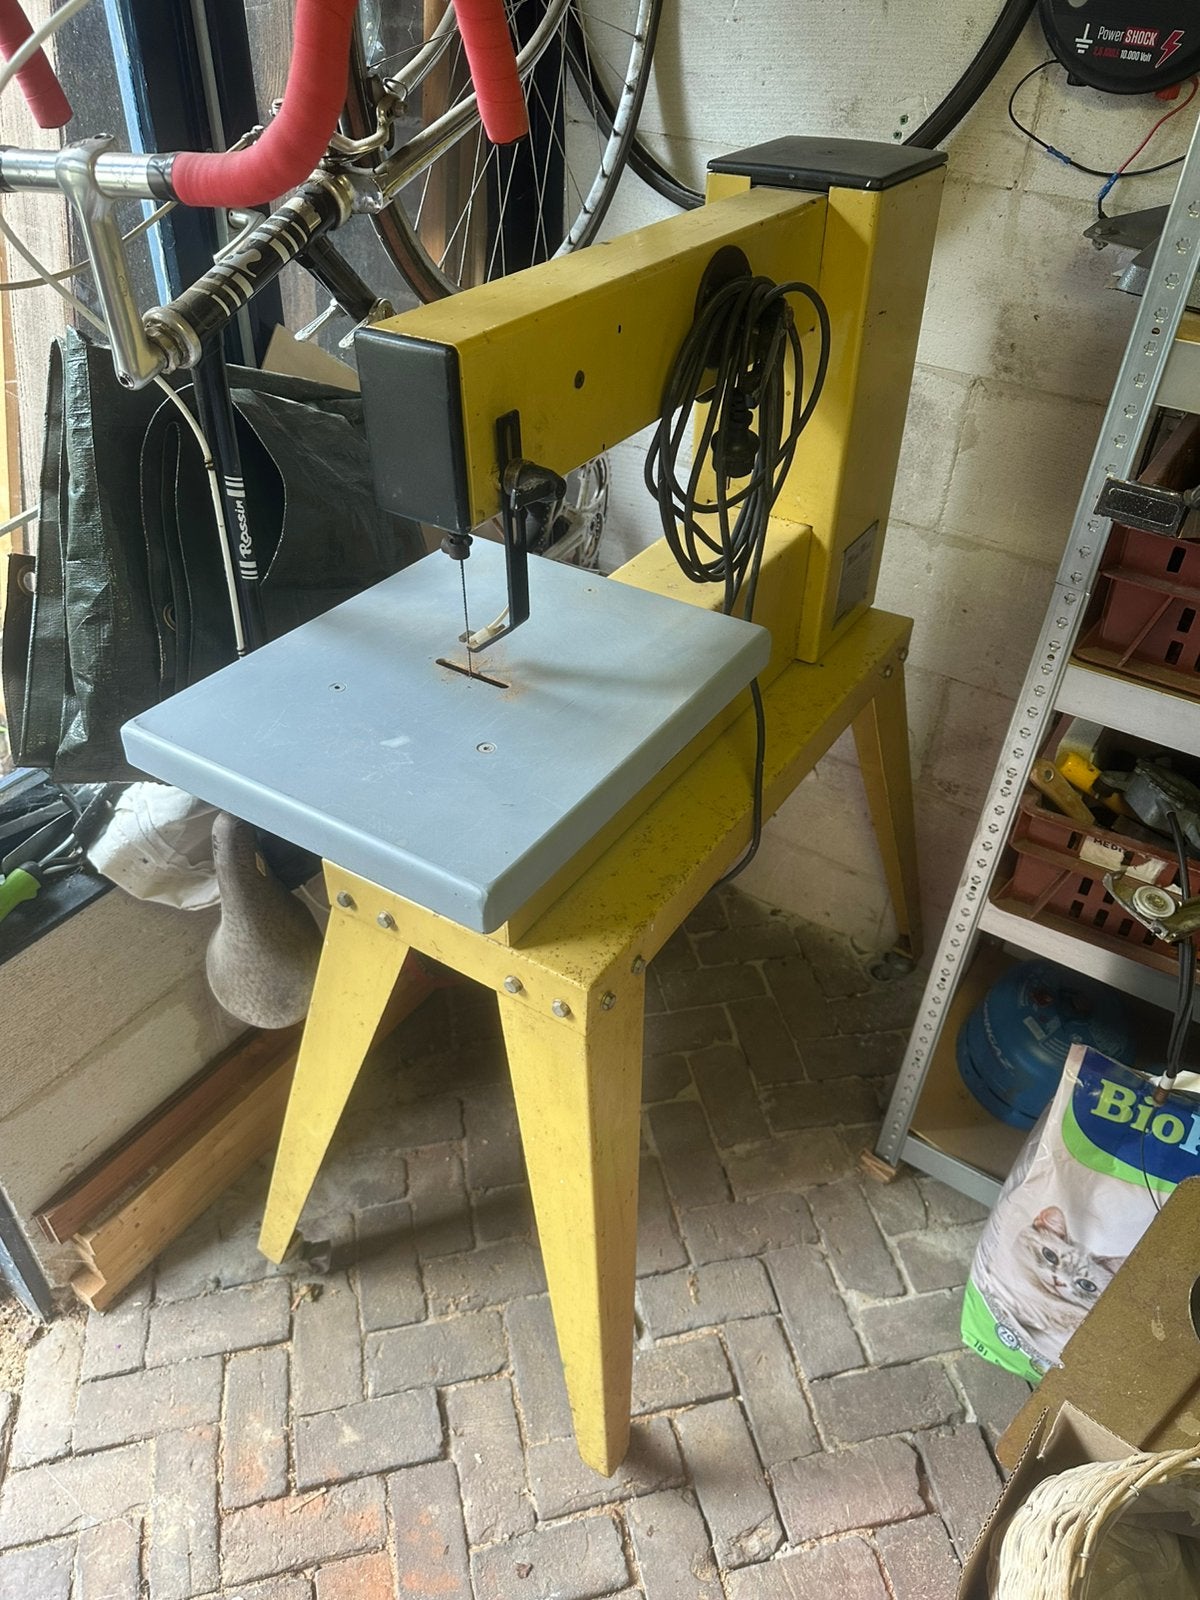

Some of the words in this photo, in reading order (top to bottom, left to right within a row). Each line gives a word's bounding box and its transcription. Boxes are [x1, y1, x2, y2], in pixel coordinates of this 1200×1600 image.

[1097, 26, 1124, 42] Power
[1125, 29, 1158, 46] SHOCK
[1120, 49, 1140, 61] 10.000
[1140, 51, 1152, 62] Volt
[235, 500, 252, 559] Rossin
